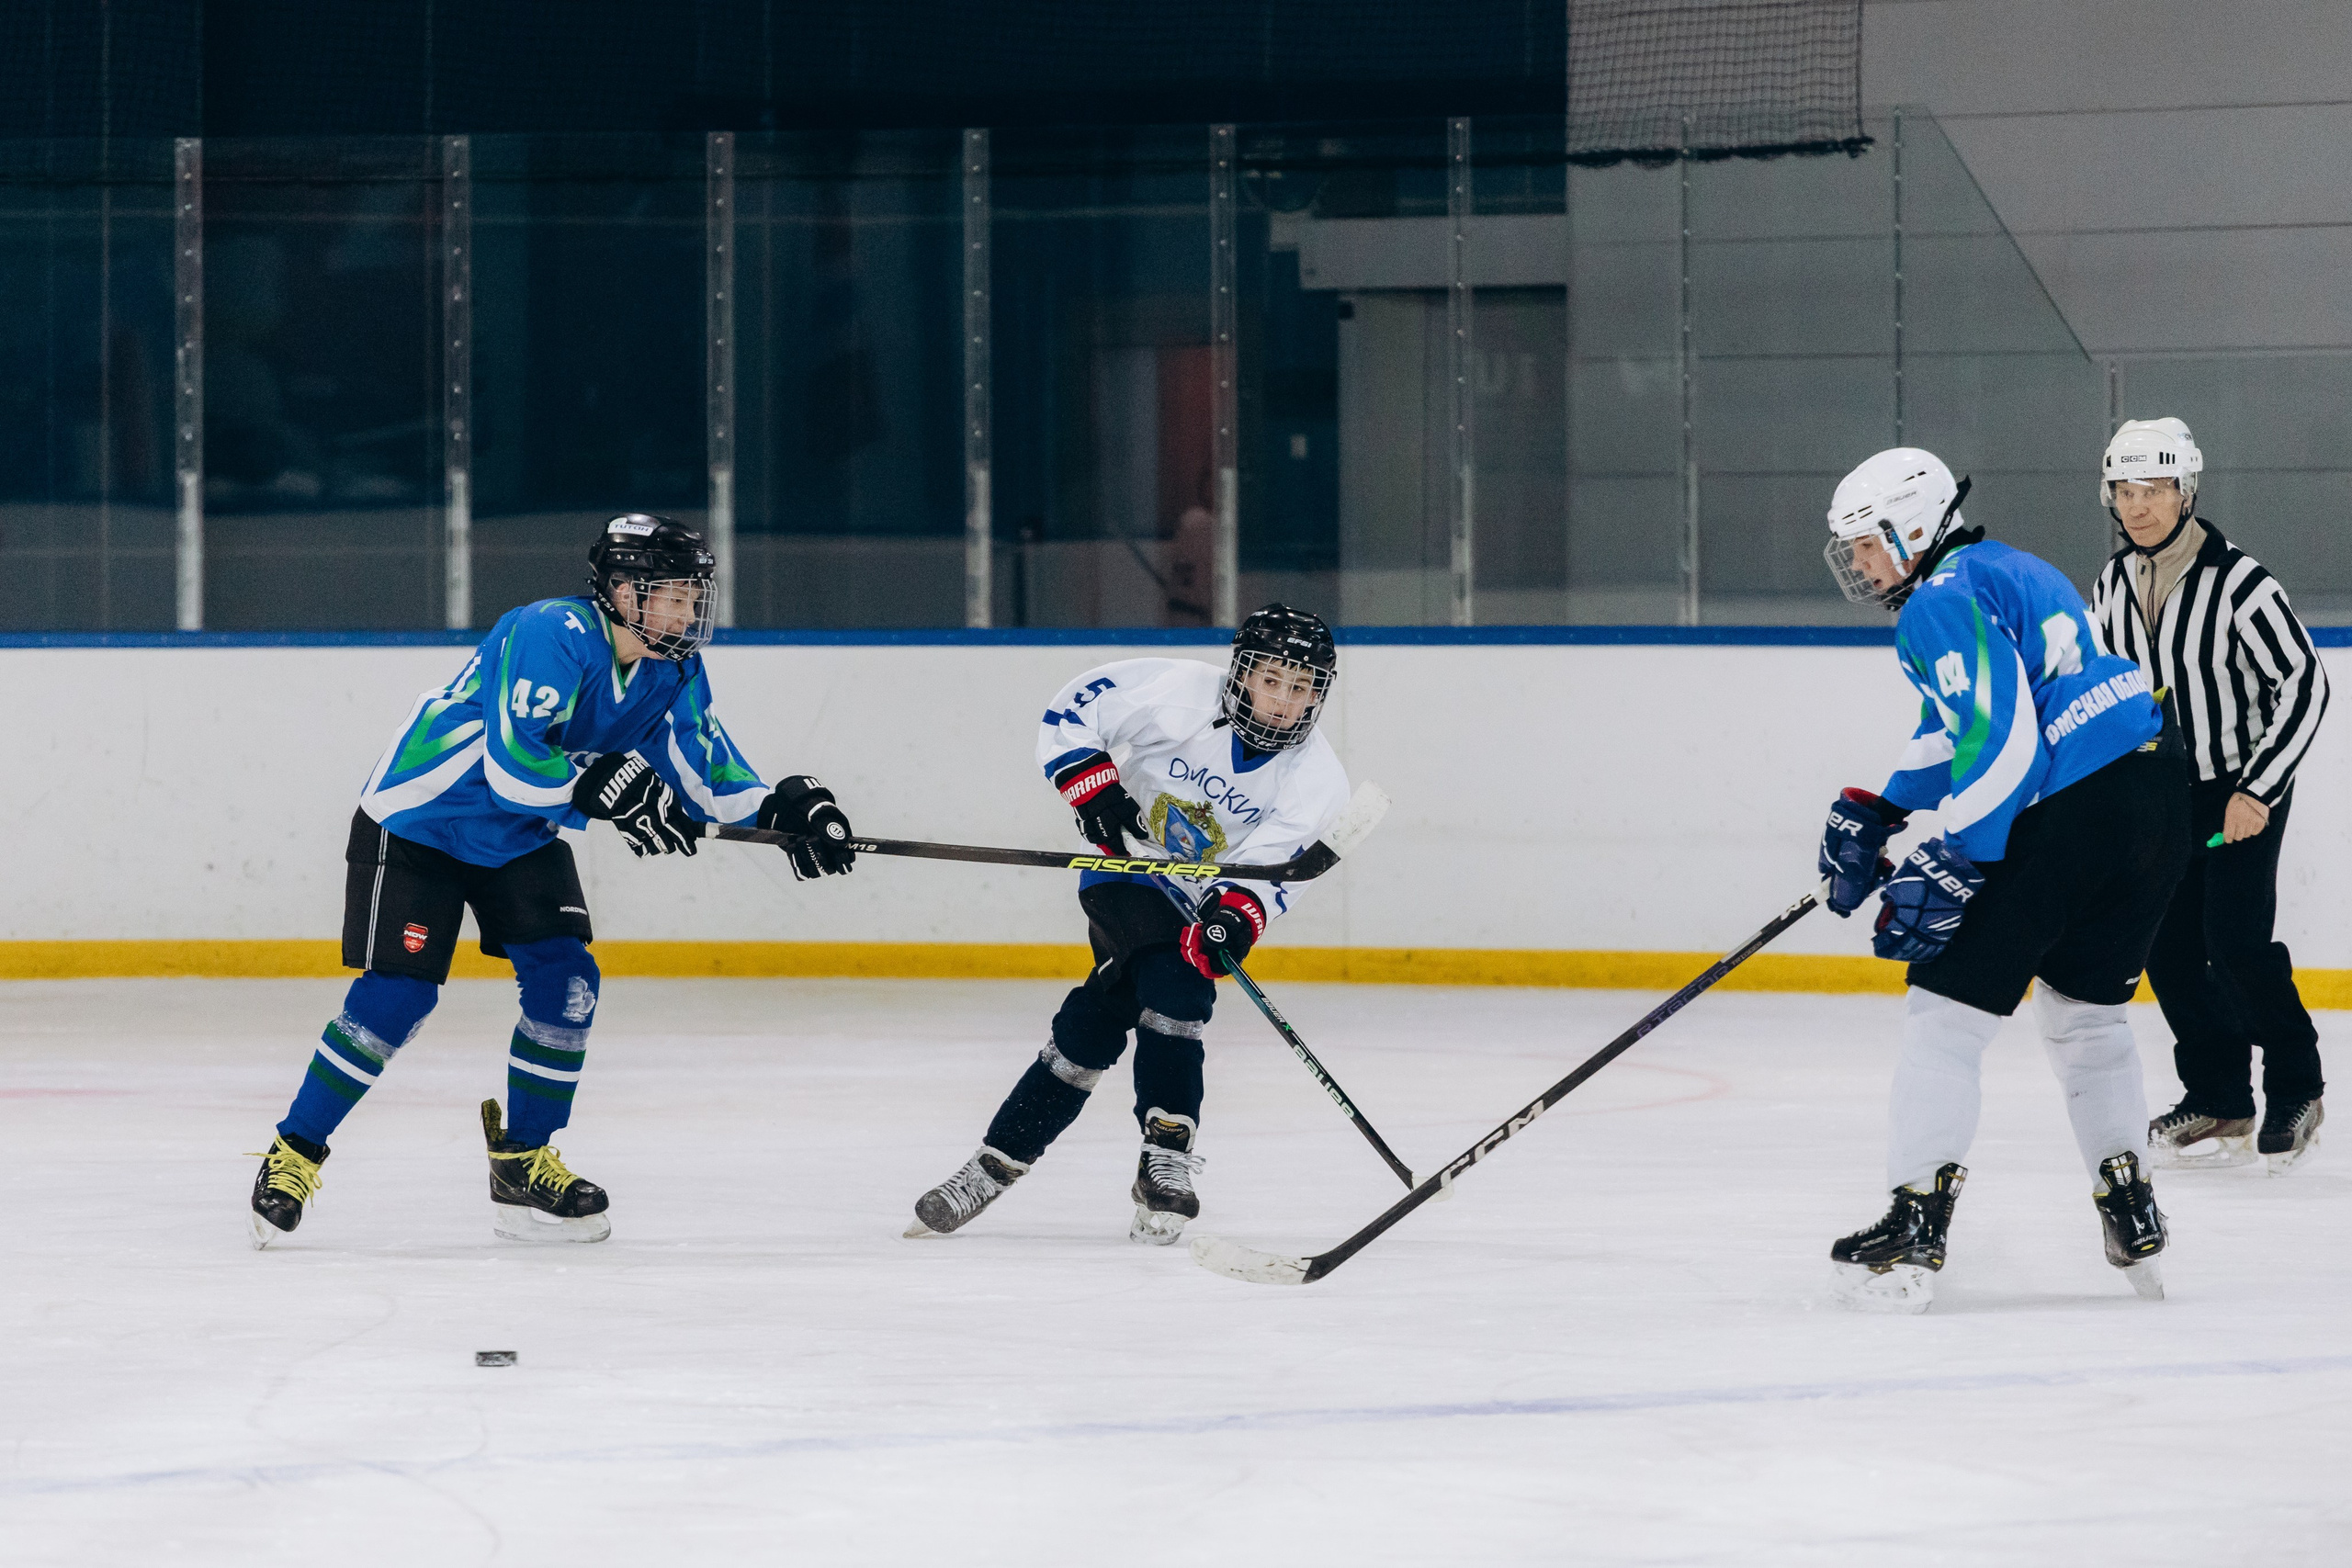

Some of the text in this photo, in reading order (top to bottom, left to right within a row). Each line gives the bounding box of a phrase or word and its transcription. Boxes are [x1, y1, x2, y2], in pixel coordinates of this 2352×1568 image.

[2121, 455, 2146, 464] CCM
[1287, 637, 1312, 649] EFSI
[512, 677, 560, 718] 42
[845, 842, 877, 852] M19
[1067, 856, 1221, 878] FISCHER
